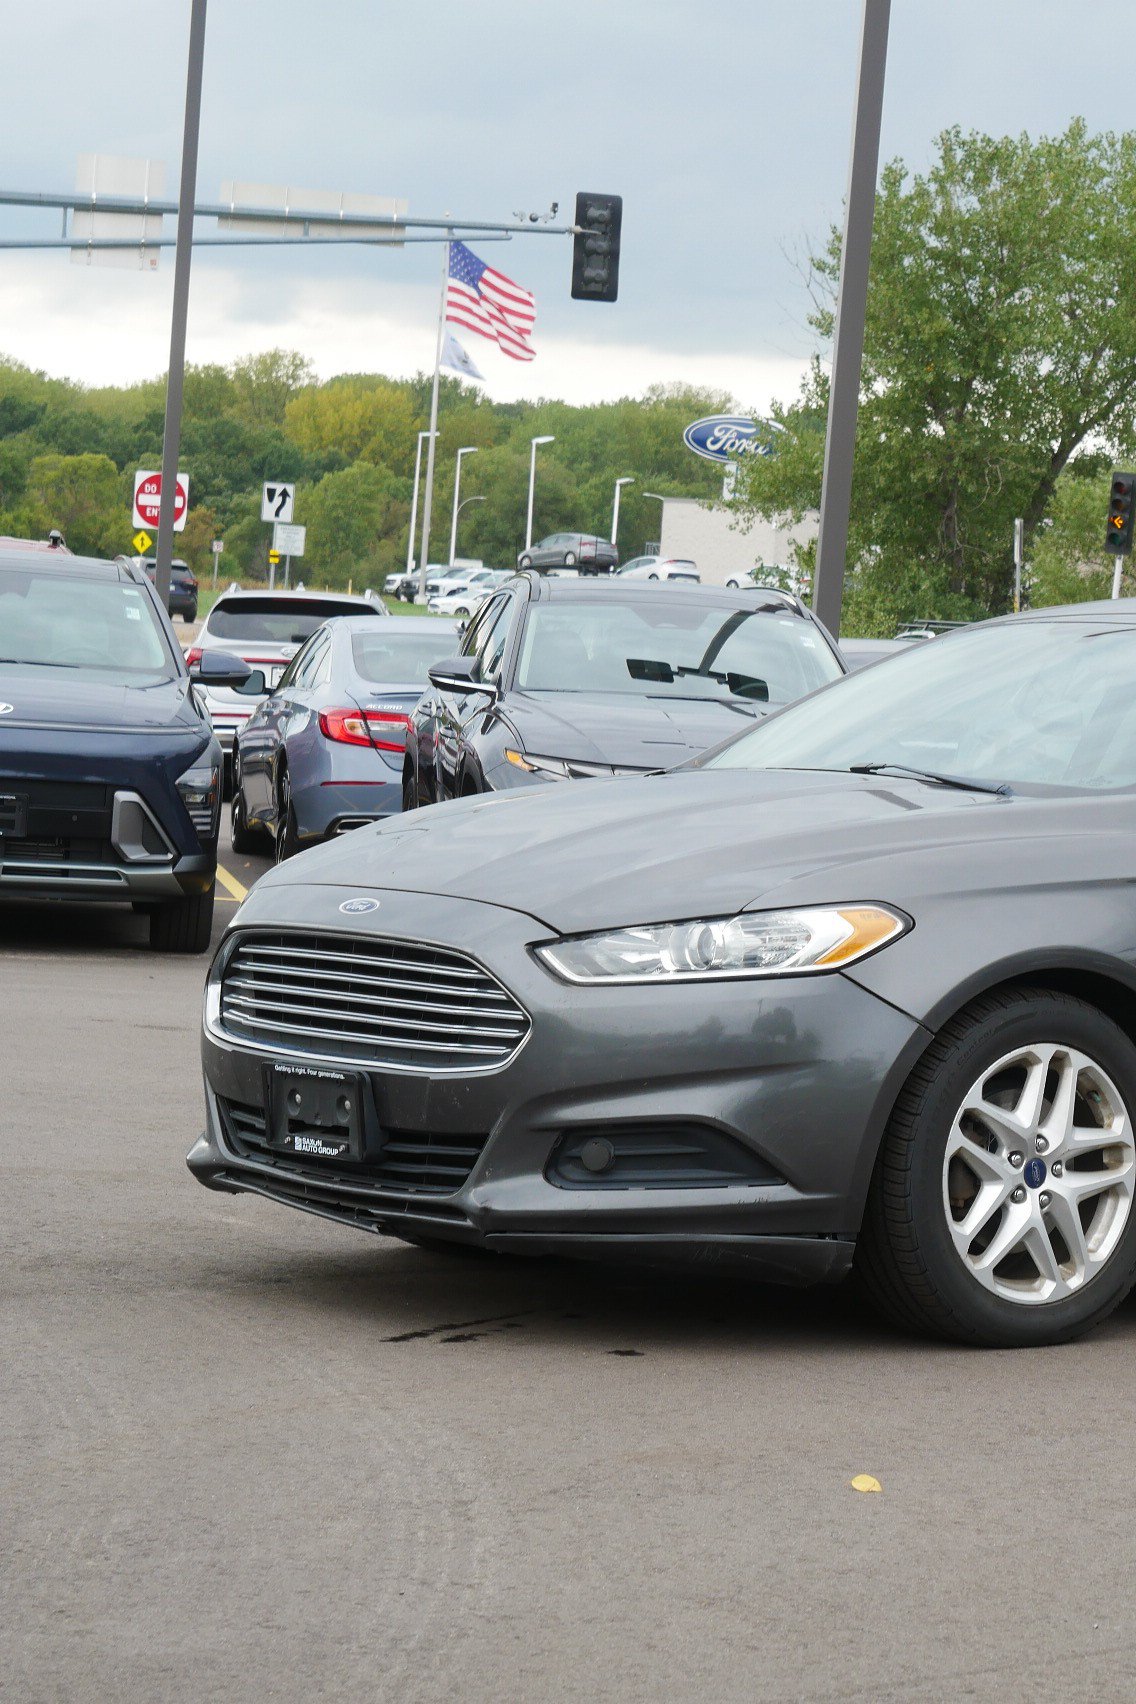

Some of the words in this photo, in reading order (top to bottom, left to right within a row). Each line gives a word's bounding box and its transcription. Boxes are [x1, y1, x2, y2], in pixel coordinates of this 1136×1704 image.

[145, 483, 157, 494] DO
[302, 1144, 317, 1153] AUTO
[318, 1147, 338, 1156] GROUP
